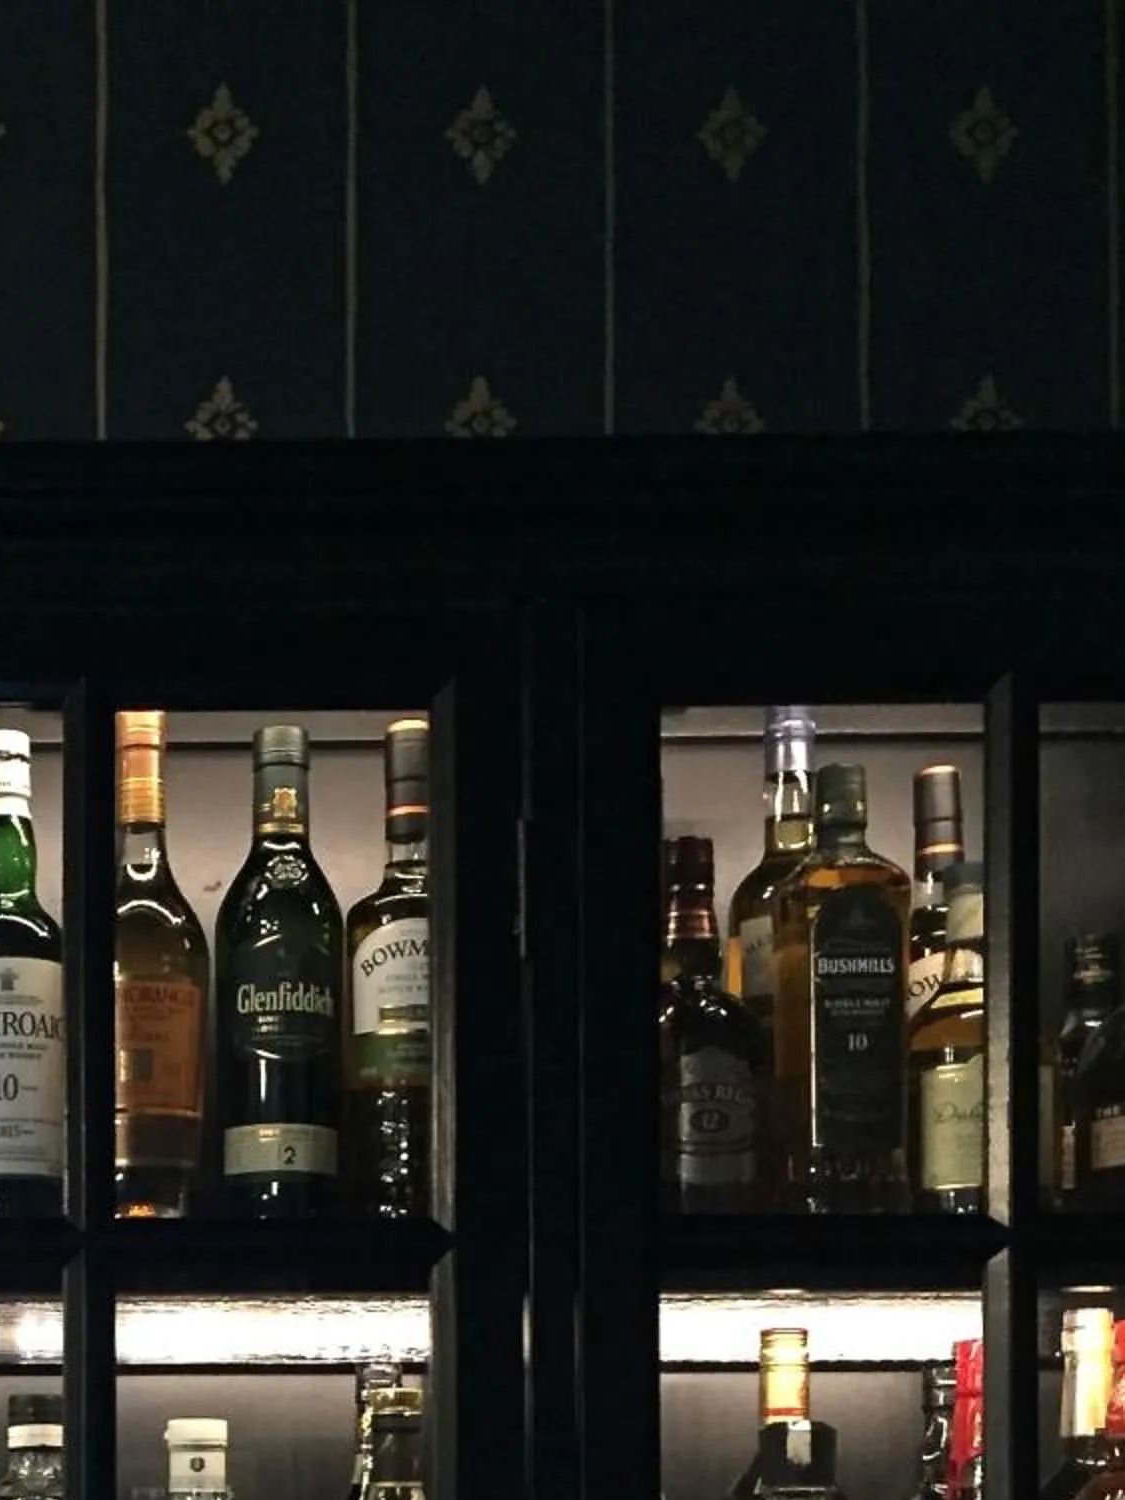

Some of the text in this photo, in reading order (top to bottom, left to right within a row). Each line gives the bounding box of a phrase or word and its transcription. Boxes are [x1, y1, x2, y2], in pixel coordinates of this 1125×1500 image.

[817, 956, 896, 975] BUSHMILLS
[236, 979, 335, 1018] Glenfiddich
[846, 1031, 869, 1052] 10
